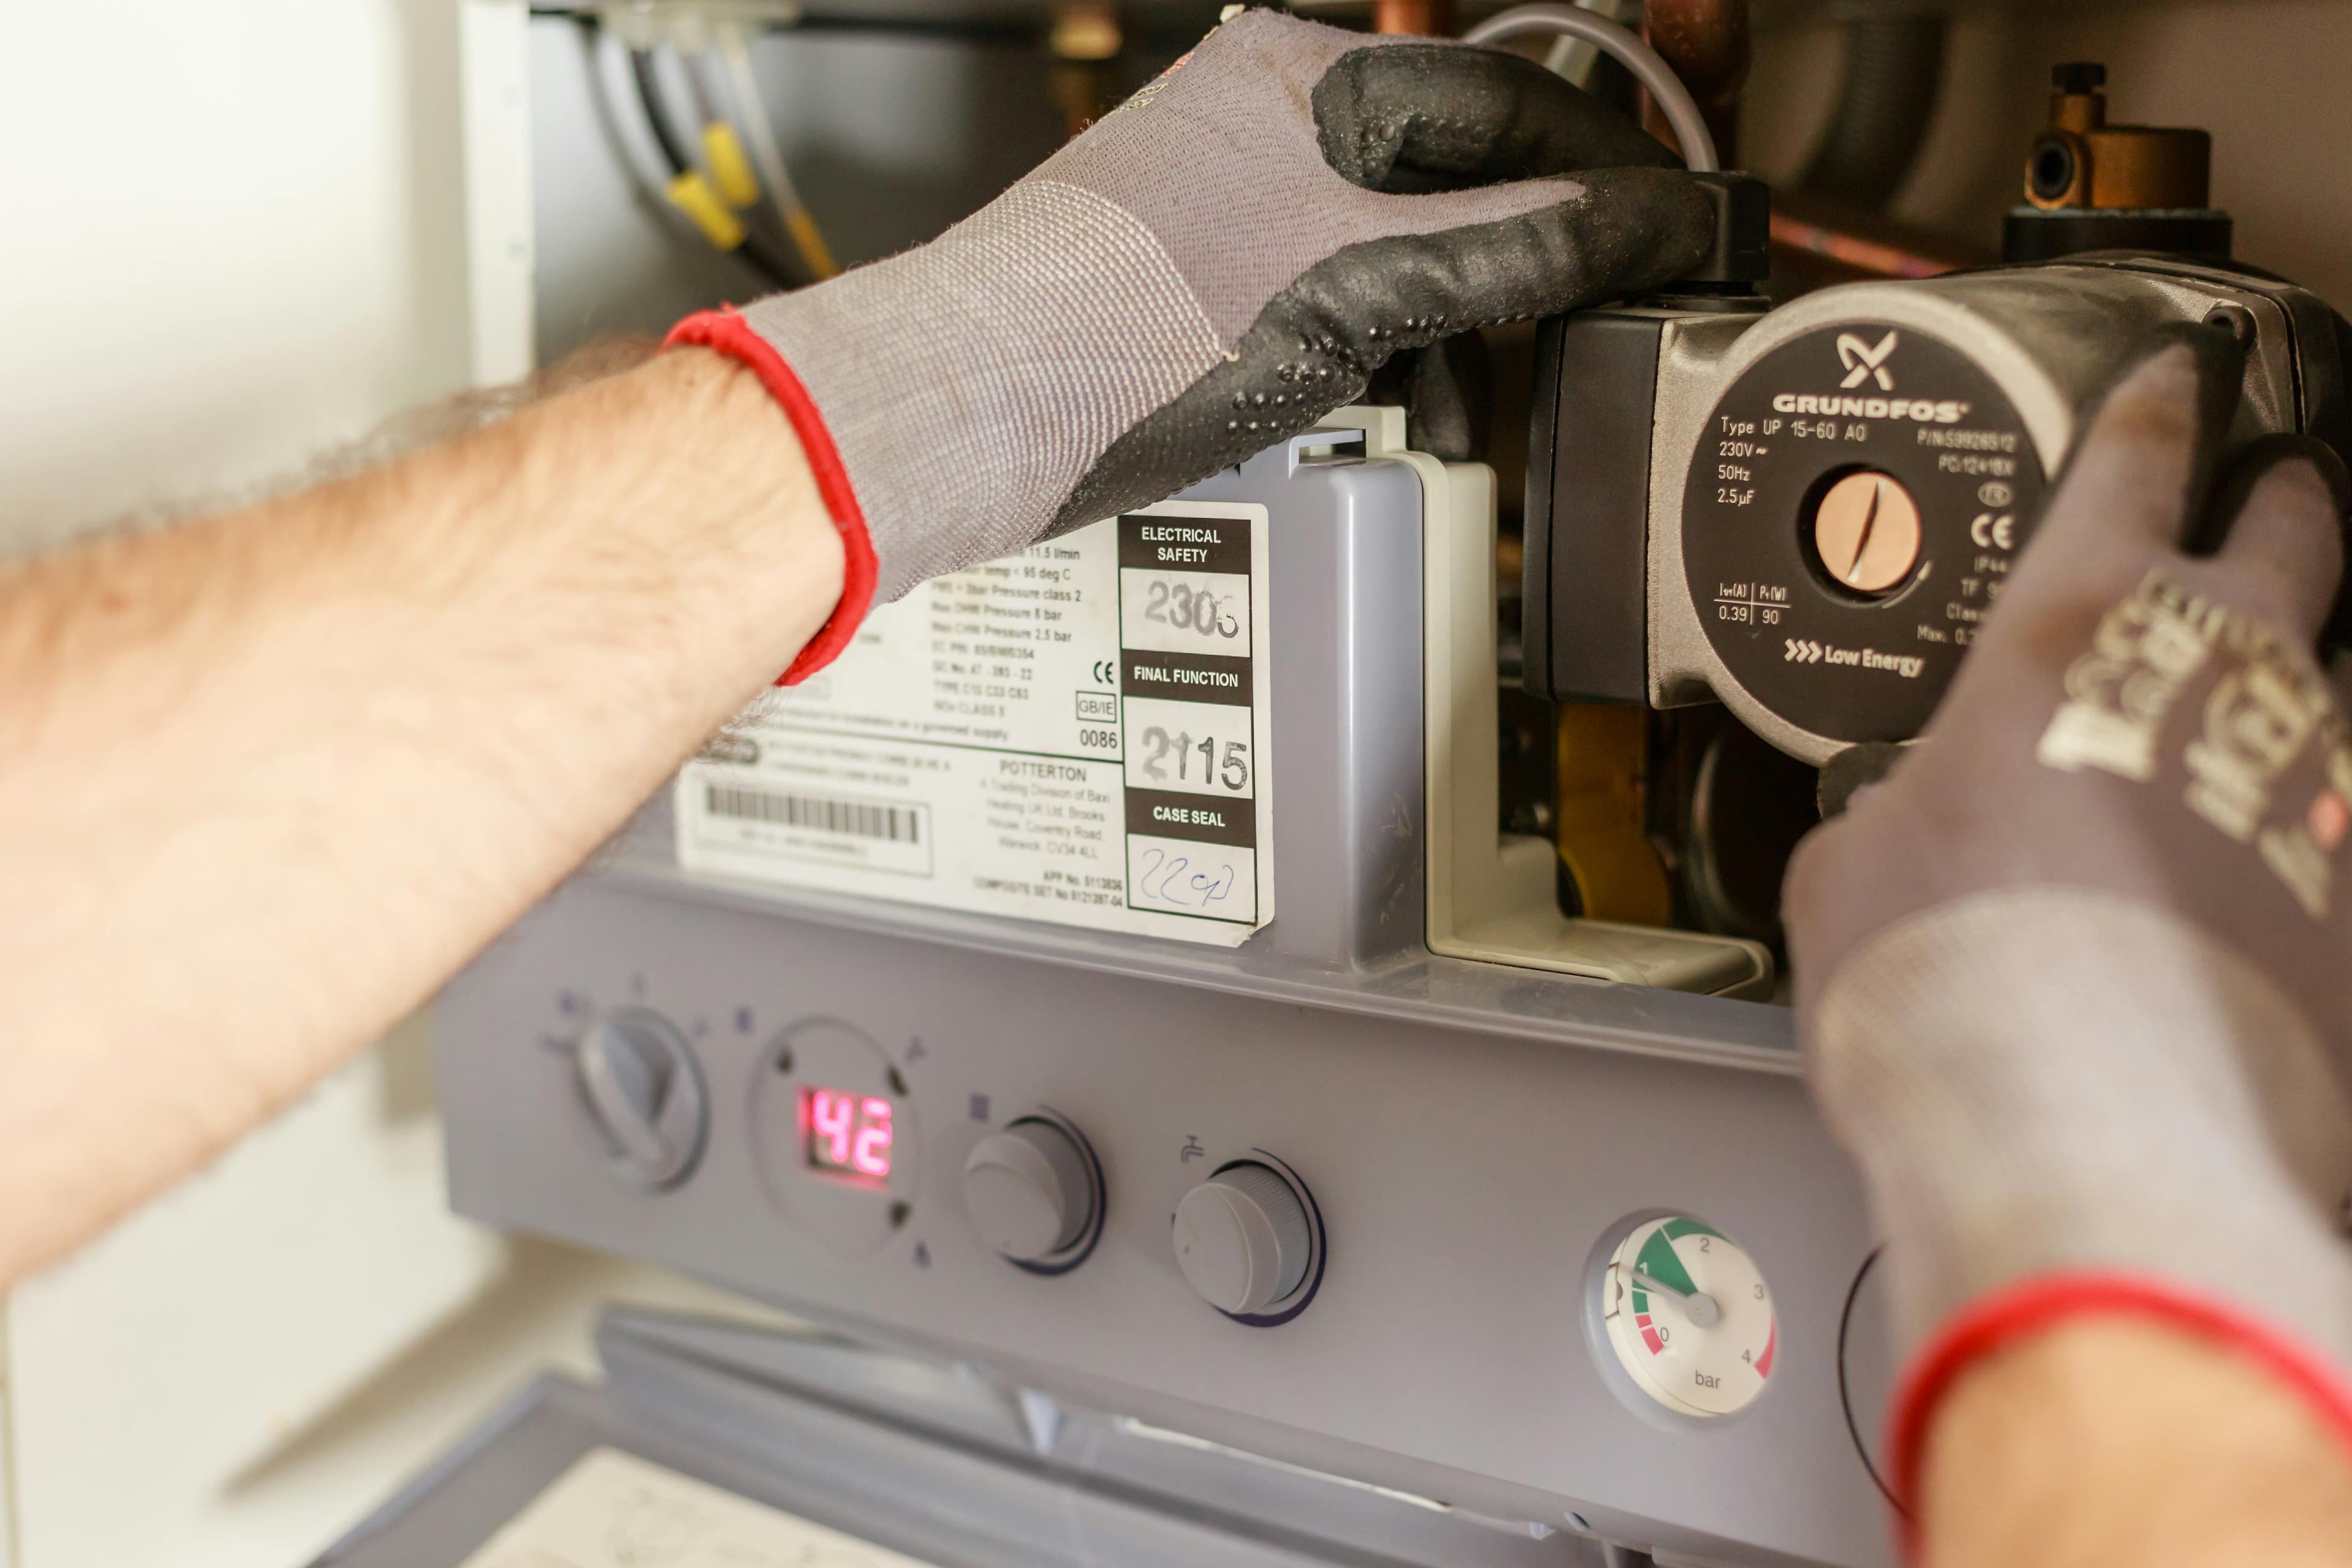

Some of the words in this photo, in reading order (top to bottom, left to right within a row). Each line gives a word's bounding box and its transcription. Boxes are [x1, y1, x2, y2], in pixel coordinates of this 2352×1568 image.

[1773, 393, 1961, 423] GRUNDFOS
[1720, 415, 1755, 437] Type
[1762, 418, 1782, 435] UP
[1790, 420, 1837, 440] 15-60
[1717, 464, 1751, 481] 50Hz
[1141, 526, 1221, 544] ELECTRICAL
[1030, 546, 1050, 559] 11.5
[1157, 547, 1208, 563] SAFETY
[1023, 567, 1036, 578] 95
[1039, 567, 1060, 582] deg
[1063, 568, 1071, 581] C
[992, 584, 1040, 600] Pressure
[1043, 588, 1072, 602] class
[1075, 590, 1082, 602] 2
[984, 603, 1031, 619] Pressure
[1044, 608, 1063, 621] bar
[1719, 605, 1747, 622] 0.39
[1762, 609, 1780, 625] 90
[984, 624, 1032, 639] Pressure
[1035, 628, 1051, 641] 2.5
[1054, 629, 1072, 643] bar
[1825, 644, 1860, 666] Low
[1862, 647, 1924, 679] Energy
[1134, 666, 1170, 683] FINAL
[1173, 668, 1238, 687] FUNCTION
[1079, 699, 1115, 715] GB/IE
[1080, 729, 1118, 749] 0086
[1142, 726, 1248, 791] 2115
[999, 760, 1087, 783] POTTERTON
[990, 778, 1028, 797] Trading
[1031, 782, 1071, 796] Division
[1074, 789, 1085, 800] of
[1087, 790, 1110, 804] Baxi
[1068, 806, 1106, 823] Brooks
[1153, 806, 1189, 823] CASE
[1191, 810, 1226, 827] SEAL
[1025, 820, 1071, 839] Coventry
[812, 1091, 892, 1176] 42
[1699, 1236, 1711, 1253] 2
[1638, 1262, 1649, 1276] 1
[1754, 1284, 1765, 1299] 3
[1659, 1327, 1669, 1341] 0
[1741, 1349, 1752, 1363] 4
[1694, 1370, 1721, 1389] bar
